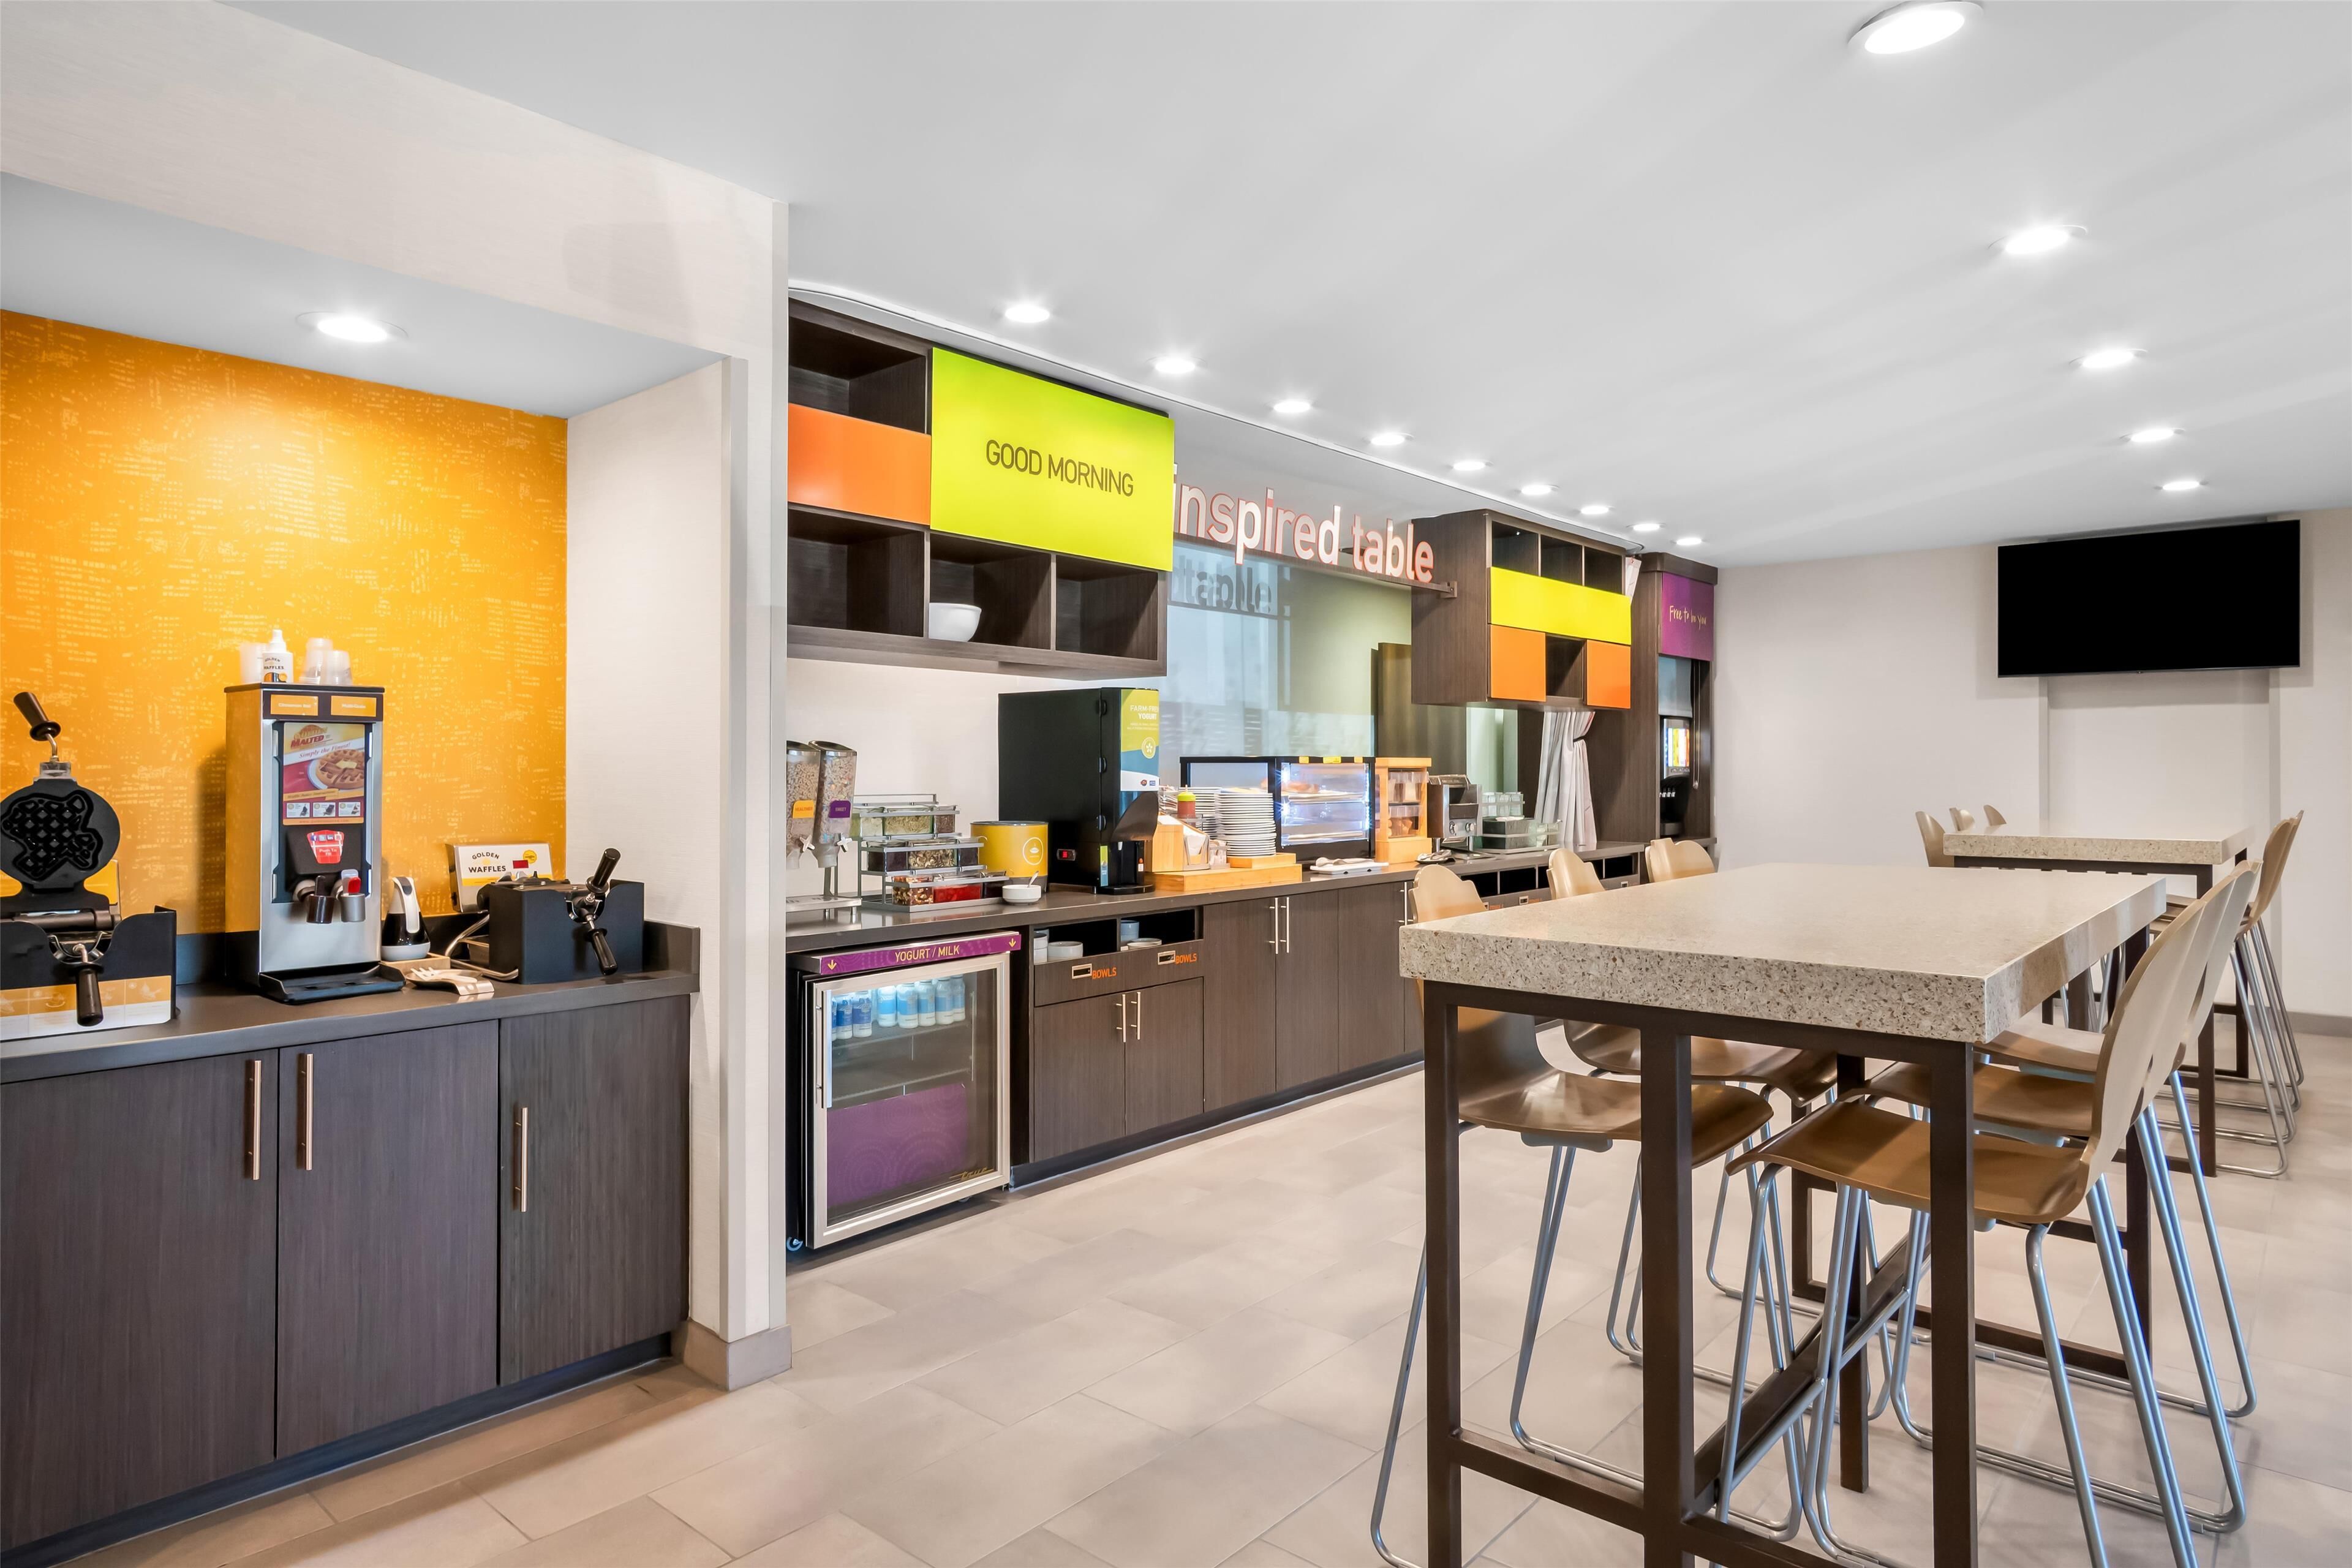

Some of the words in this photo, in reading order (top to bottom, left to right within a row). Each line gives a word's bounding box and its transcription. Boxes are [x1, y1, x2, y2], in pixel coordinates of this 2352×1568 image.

[986, 439, 1042, 476] GOOD
[1048, 453, 1134, 497] MORNING
[1351, 514, 1434, 583] table
[1669, 605, 1683, 622] Free
[1683, 608, 1689, 623] to
[1697, 615, 1707, 630] you
[291, 734, 325, 748] MALTED
[299, 749, 319, 759] Simply
[472, 851, 500, 860] GOLDEN
[895, 948, 931, 962] YOGURT
[938, 945, 960, 957] MILK
[1175, 953, 1197, 965] BOWLS
[1092, 967, 1117, 979] BOWLS
